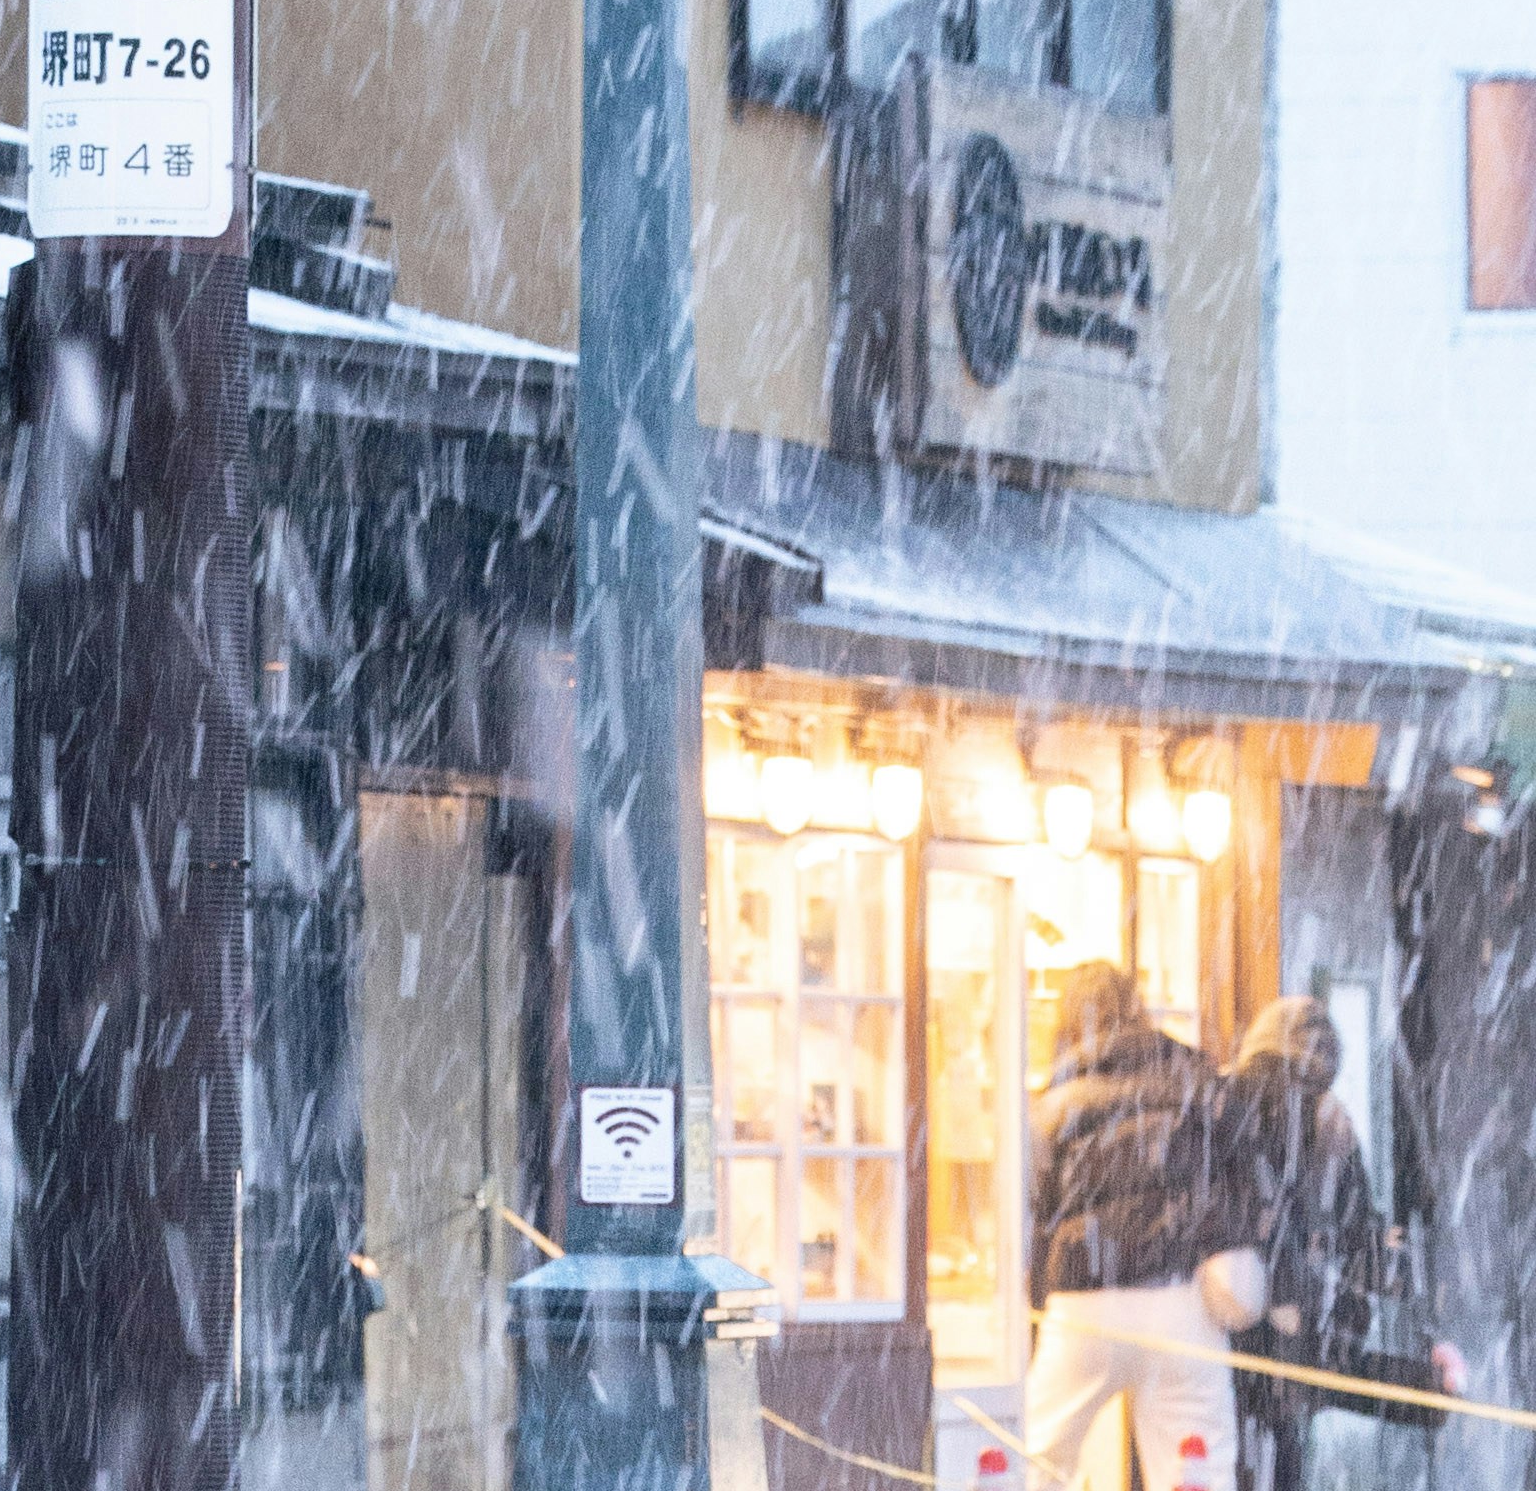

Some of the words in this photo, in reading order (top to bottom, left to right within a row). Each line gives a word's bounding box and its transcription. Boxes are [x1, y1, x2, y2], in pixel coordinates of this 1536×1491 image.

[42, 30, 211, 87] 堺町7-26
[46, 112, 78, 129] ここは
